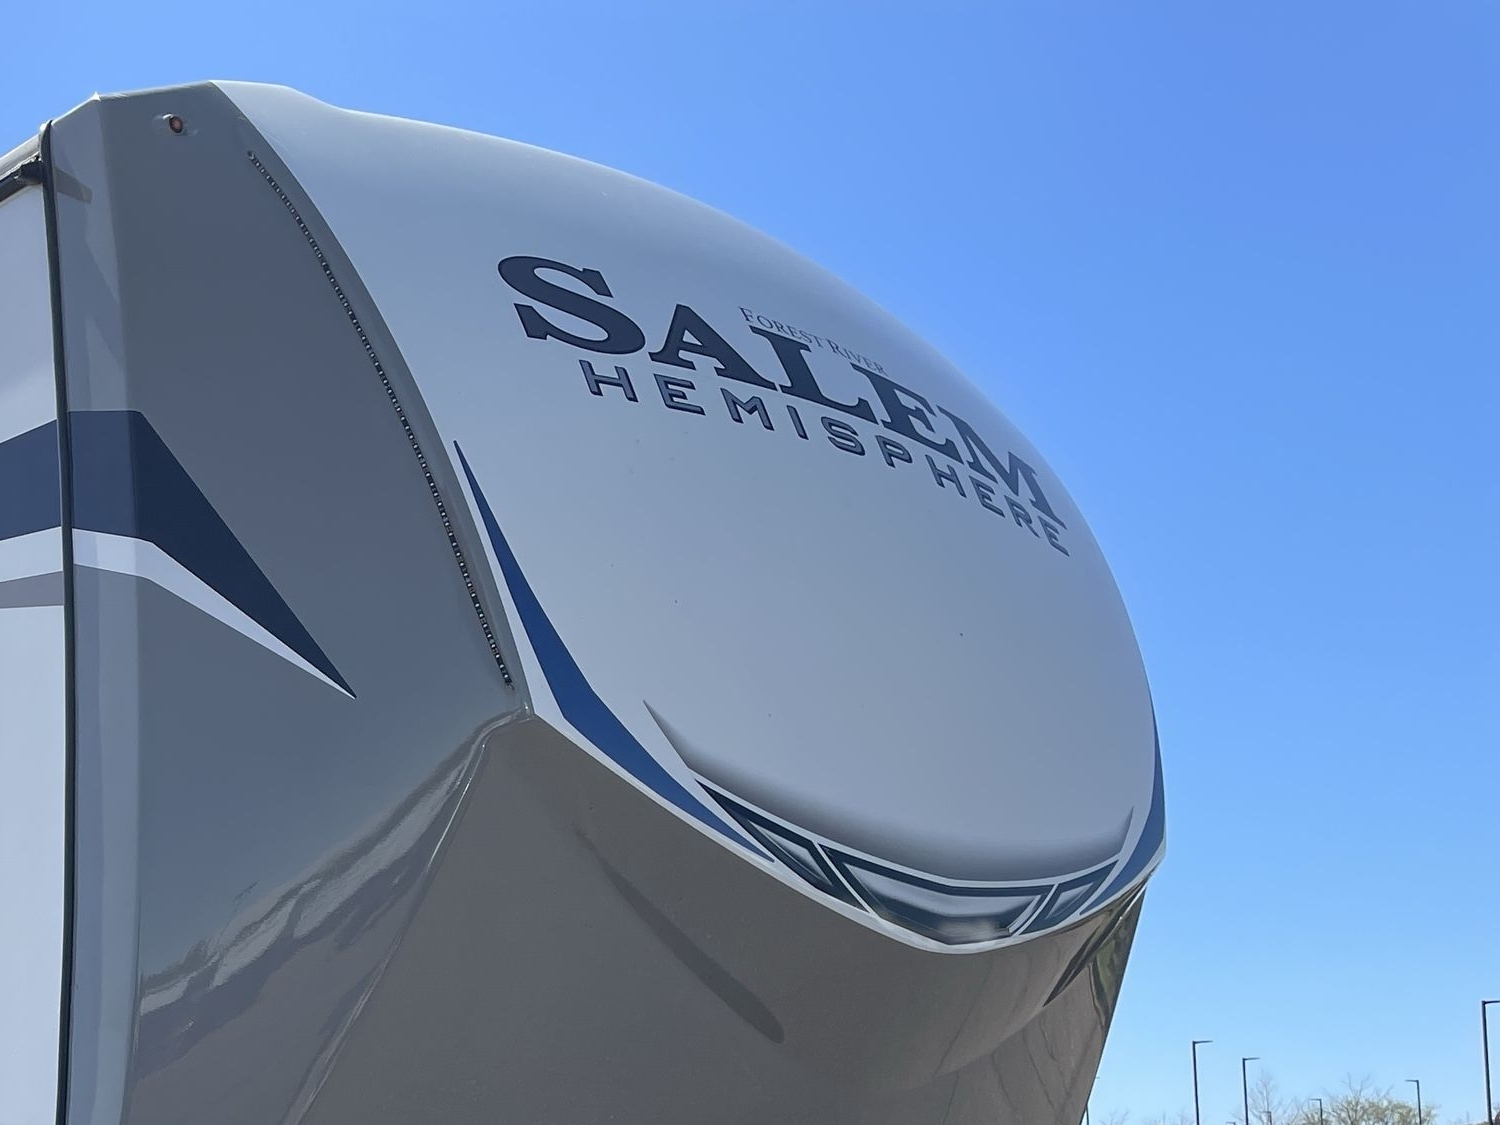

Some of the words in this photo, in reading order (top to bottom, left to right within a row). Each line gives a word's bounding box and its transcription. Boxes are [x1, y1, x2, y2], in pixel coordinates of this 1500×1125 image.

[498, 255, 1067, 529] SALEM
[738, 306, 825, 349] FOREST
[826, 337, 890, 377] RIVER
[578, 358, 1070, 557] HEMISPHERE
